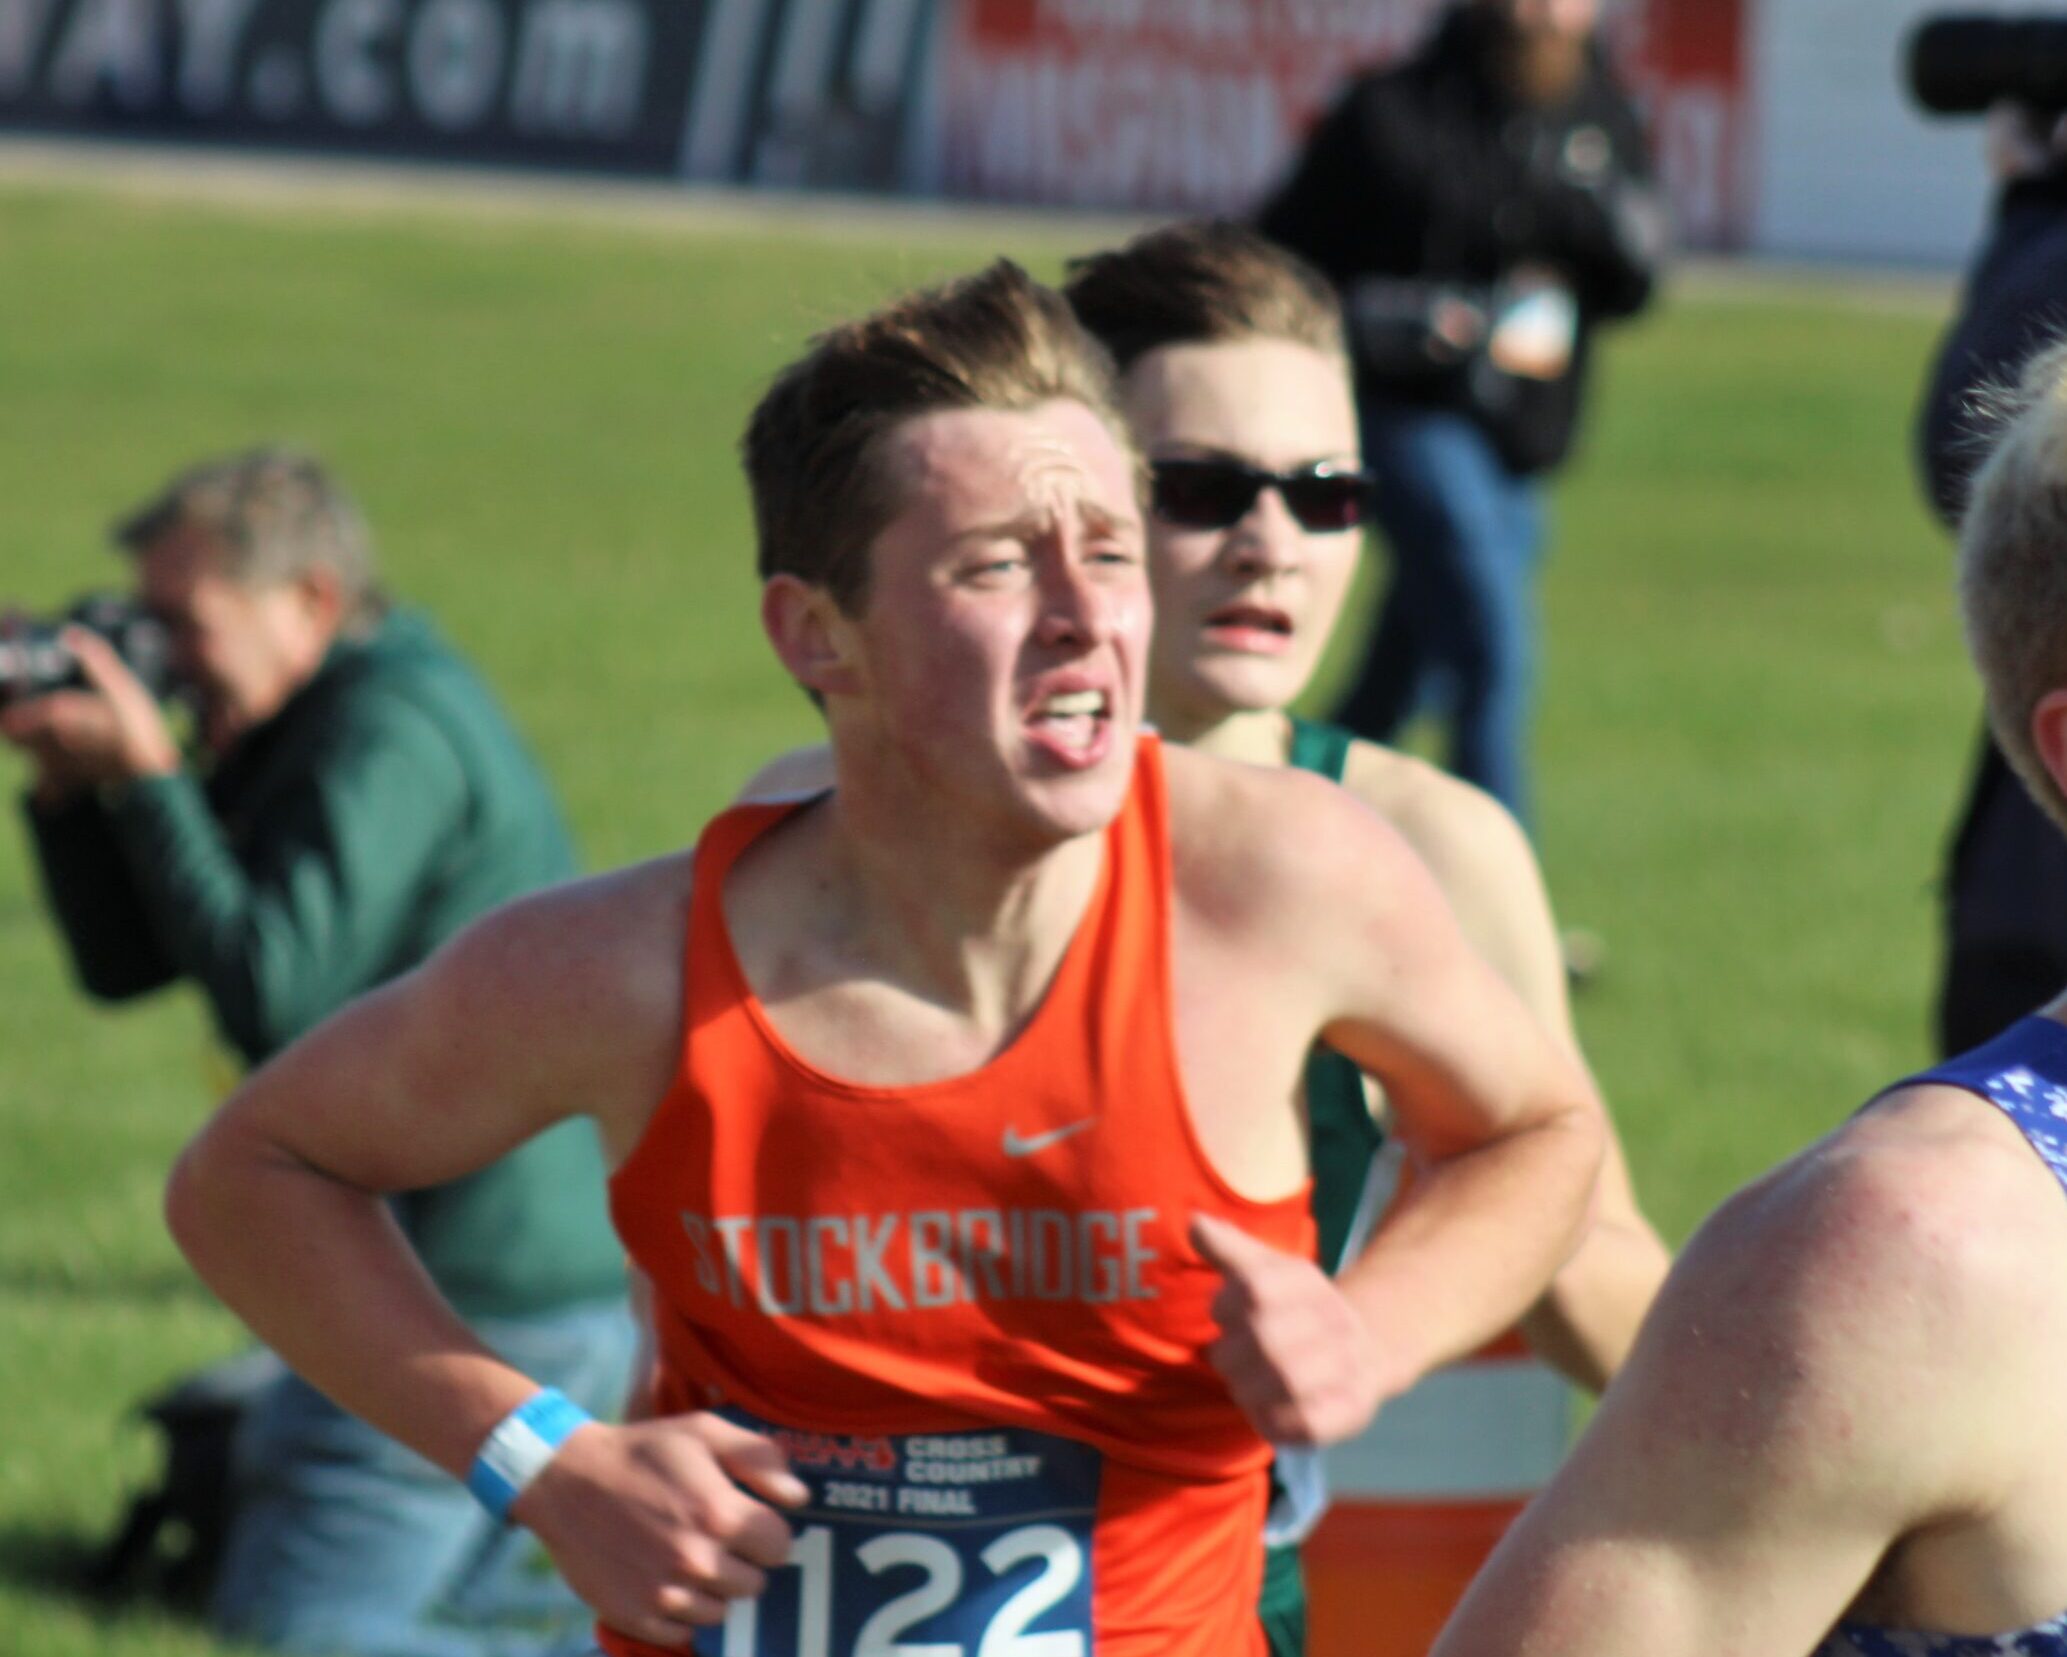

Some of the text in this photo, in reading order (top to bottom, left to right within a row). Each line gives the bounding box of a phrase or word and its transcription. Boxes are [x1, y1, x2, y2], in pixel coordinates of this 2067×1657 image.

[0, 0, 652, 138] AY.com
[680, 1207, 1160, 1316] STOCKBRIDGE
[905, 1434, 1007, 1459] CROSS
[905, 1455, 1041, 1484] COUNTRY
[825, 1481, 977, 1515] 2021 FINAL
